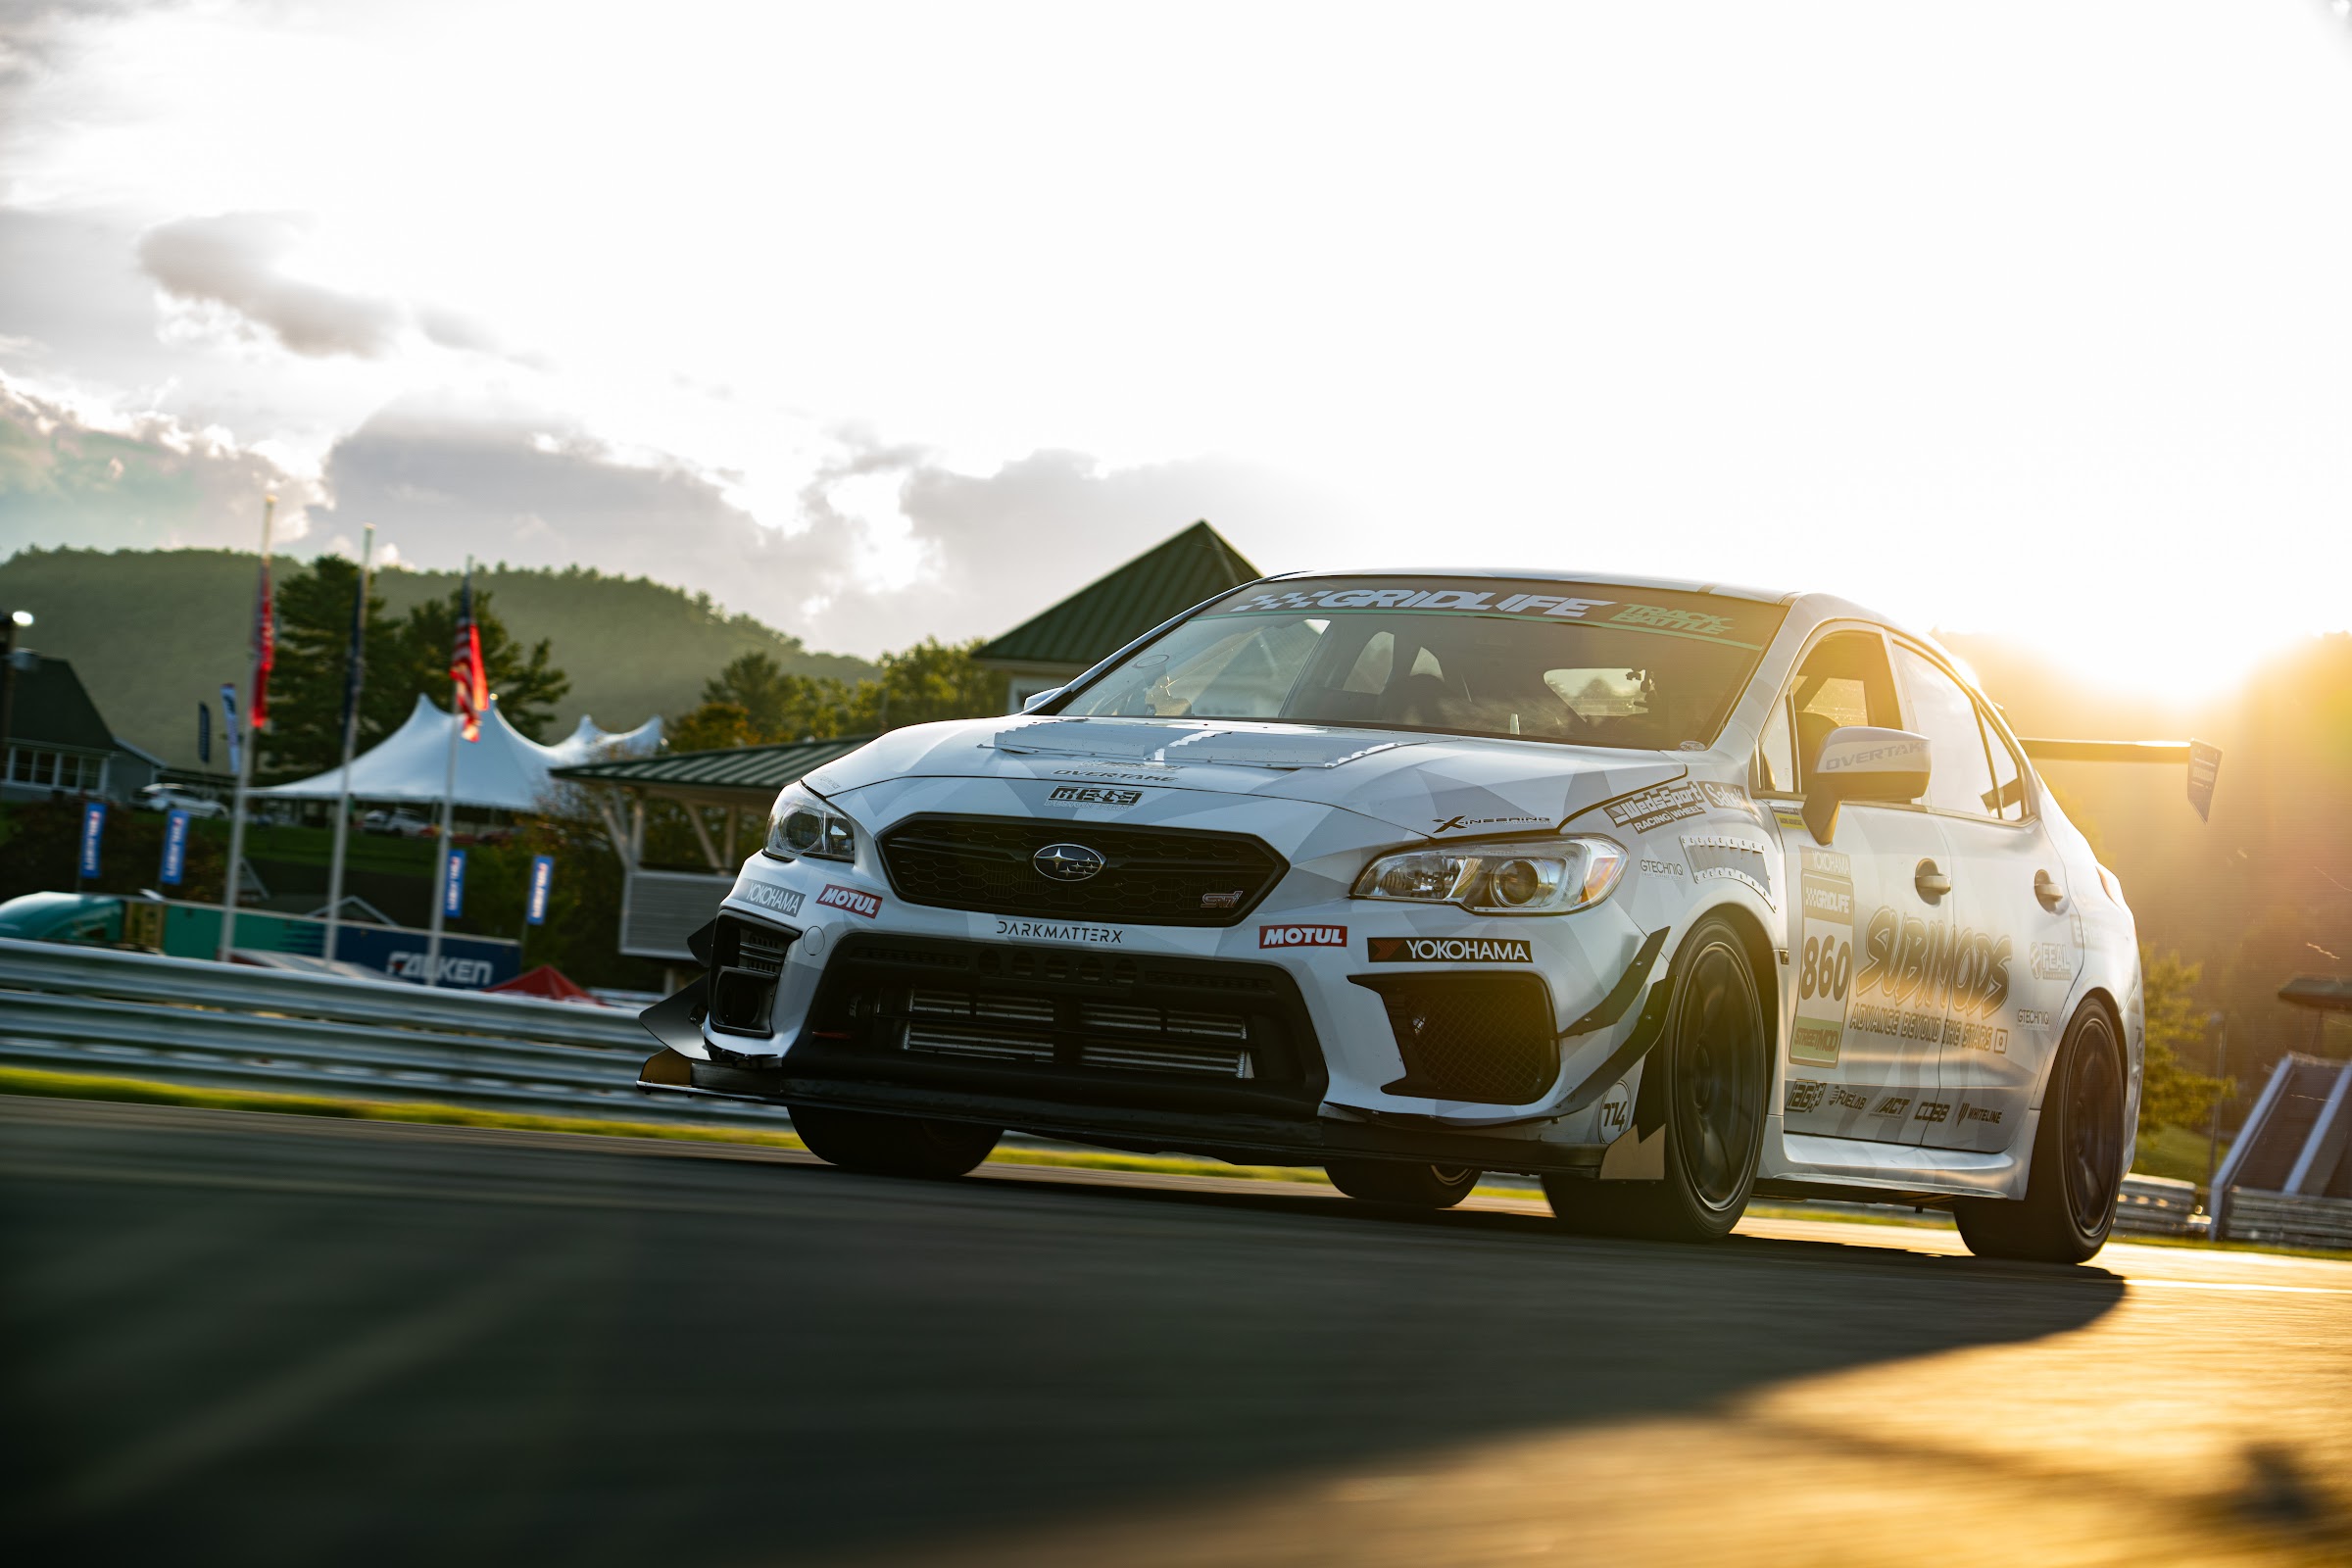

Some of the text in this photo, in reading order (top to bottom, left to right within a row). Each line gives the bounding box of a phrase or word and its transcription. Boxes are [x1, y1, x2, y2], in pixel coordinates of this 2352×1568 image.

[1316, 589, 1618, 618] GRIDLIFE
[1621, 603, 1736, 626] TRACK
[1609, 612, 1735, 635] BATTLE
[1052, 769, 1182, 781] OVERTAKE
[1620, 784, 1703, 819] WedsSport
[1634, 804, 1703, 832] RACING WHEEL
[1640, 858, 1684, 876] GTECHNIQ
[1811, 850, 1851, 875] YOKOHAMA
[746, 882, 800, 914] YOKOHAMA
[819, 888, 877, 915] MOTUL
[1816, 889, 1851, 914] GRIDLIFE
[996, 920, 1124, 944] DARKMATTERX
[1262, 927, 1344, 947] MOTUL
[1405, 940, 1530, 961] YOKOHAMA
[2042, 942, 2072, 970] FEAL
[1801, 935, 1851, 1002] 860
[1856, 905, 2013, 1021] SUBIMODS
[1849, 1003, 1993, 1052] ADVANCE BEYOND THE STARS
[1836, 1089, 1868, 1110] FUELAB
[1879, 1097, 1911, 1115] ACT
[1913, 1102, 1951, 1123] COBB
[1967, 1107, 2002, 1125] WHITELINE
